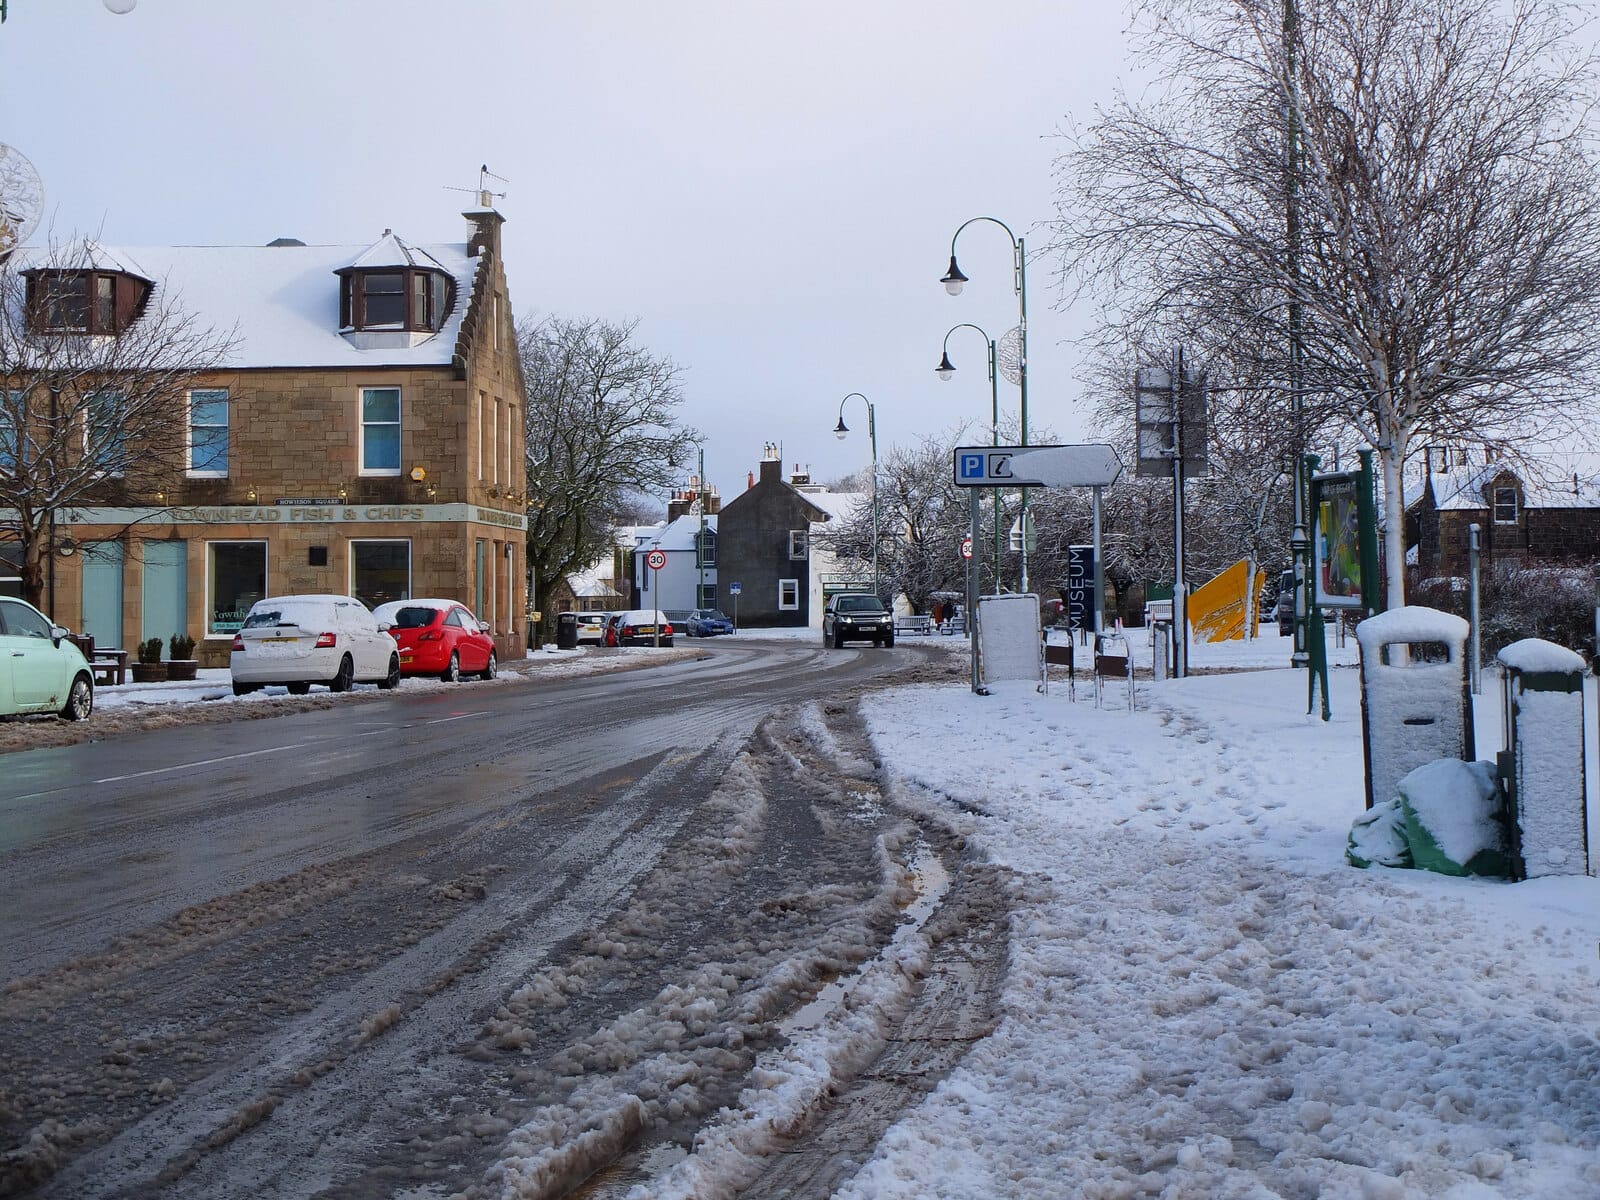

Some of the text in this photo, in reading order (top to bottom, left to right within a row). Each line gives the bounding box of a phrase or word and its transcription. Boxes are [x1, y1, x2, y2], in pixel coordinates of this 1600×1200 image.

[965, 456, 979, 476] P
[172, 508, 425, 521] TOWNHEAD FISH & CHIPS
[650, 555, 663, 564] 30
[1069, 548, 1085, 632] MUSEUM
